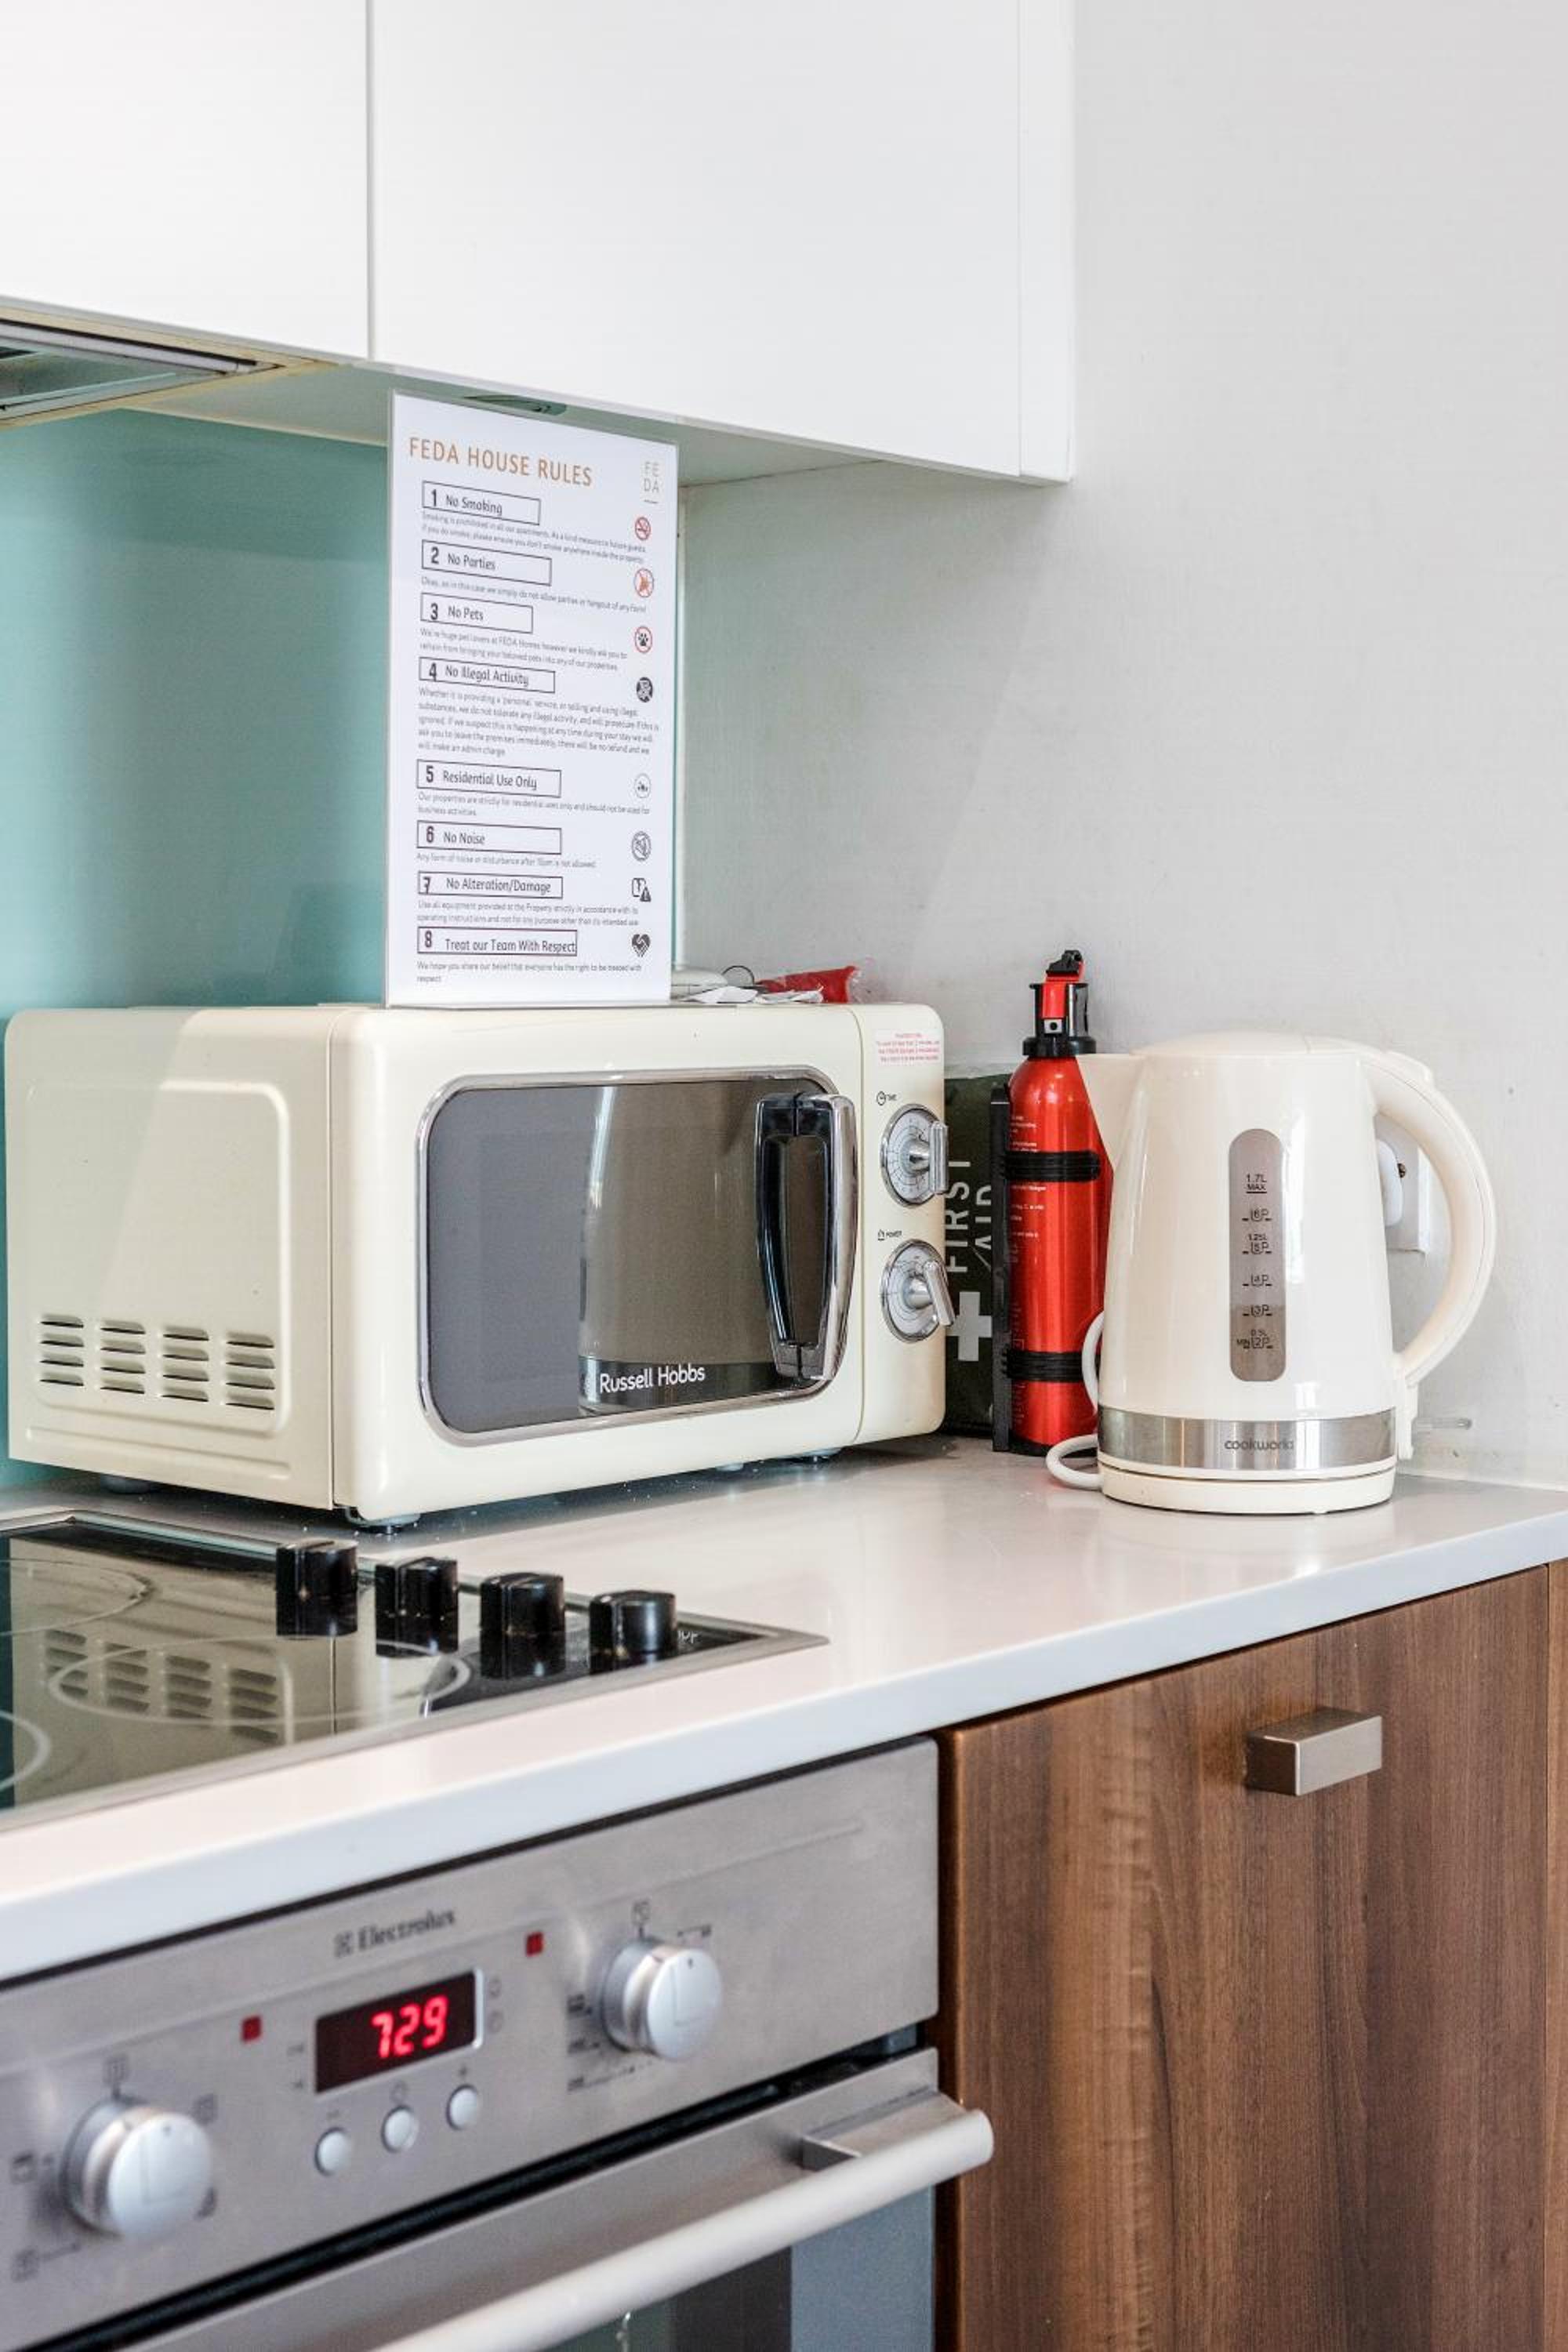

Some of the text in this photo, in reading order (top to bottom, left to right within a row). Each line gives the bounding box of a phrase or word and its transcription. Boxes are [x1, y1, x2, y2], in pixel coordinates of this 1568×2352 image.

[408, 437, 593, 487] FEDA HOUSE RULES
[643, 477, 660, 493] DA
[431, 488, 503, 517] 1 No Smoking
[431, 546, 496, 570] 2 No Parties
[430, 603, 484, 621] 3 No Pets
[429, 662, 529, 687] 4 No Illegal Activity
[426, 765, 537, 790] 5 Residential Use Only
[426, 826, 485, 844] 6 No Noise
[423, 877, 551, 895] 7 No Alteration/Damage
[425, 930, 576, 954] 8 Treat our Team With Respect
[1247, 1174, 1267, 1182] 1.7L
[599, 1363, 706, 1393] Russell Hobbs
[358, 1910, 455, 1951] Electrolux
[371, 1995, 449, 2058] 729
